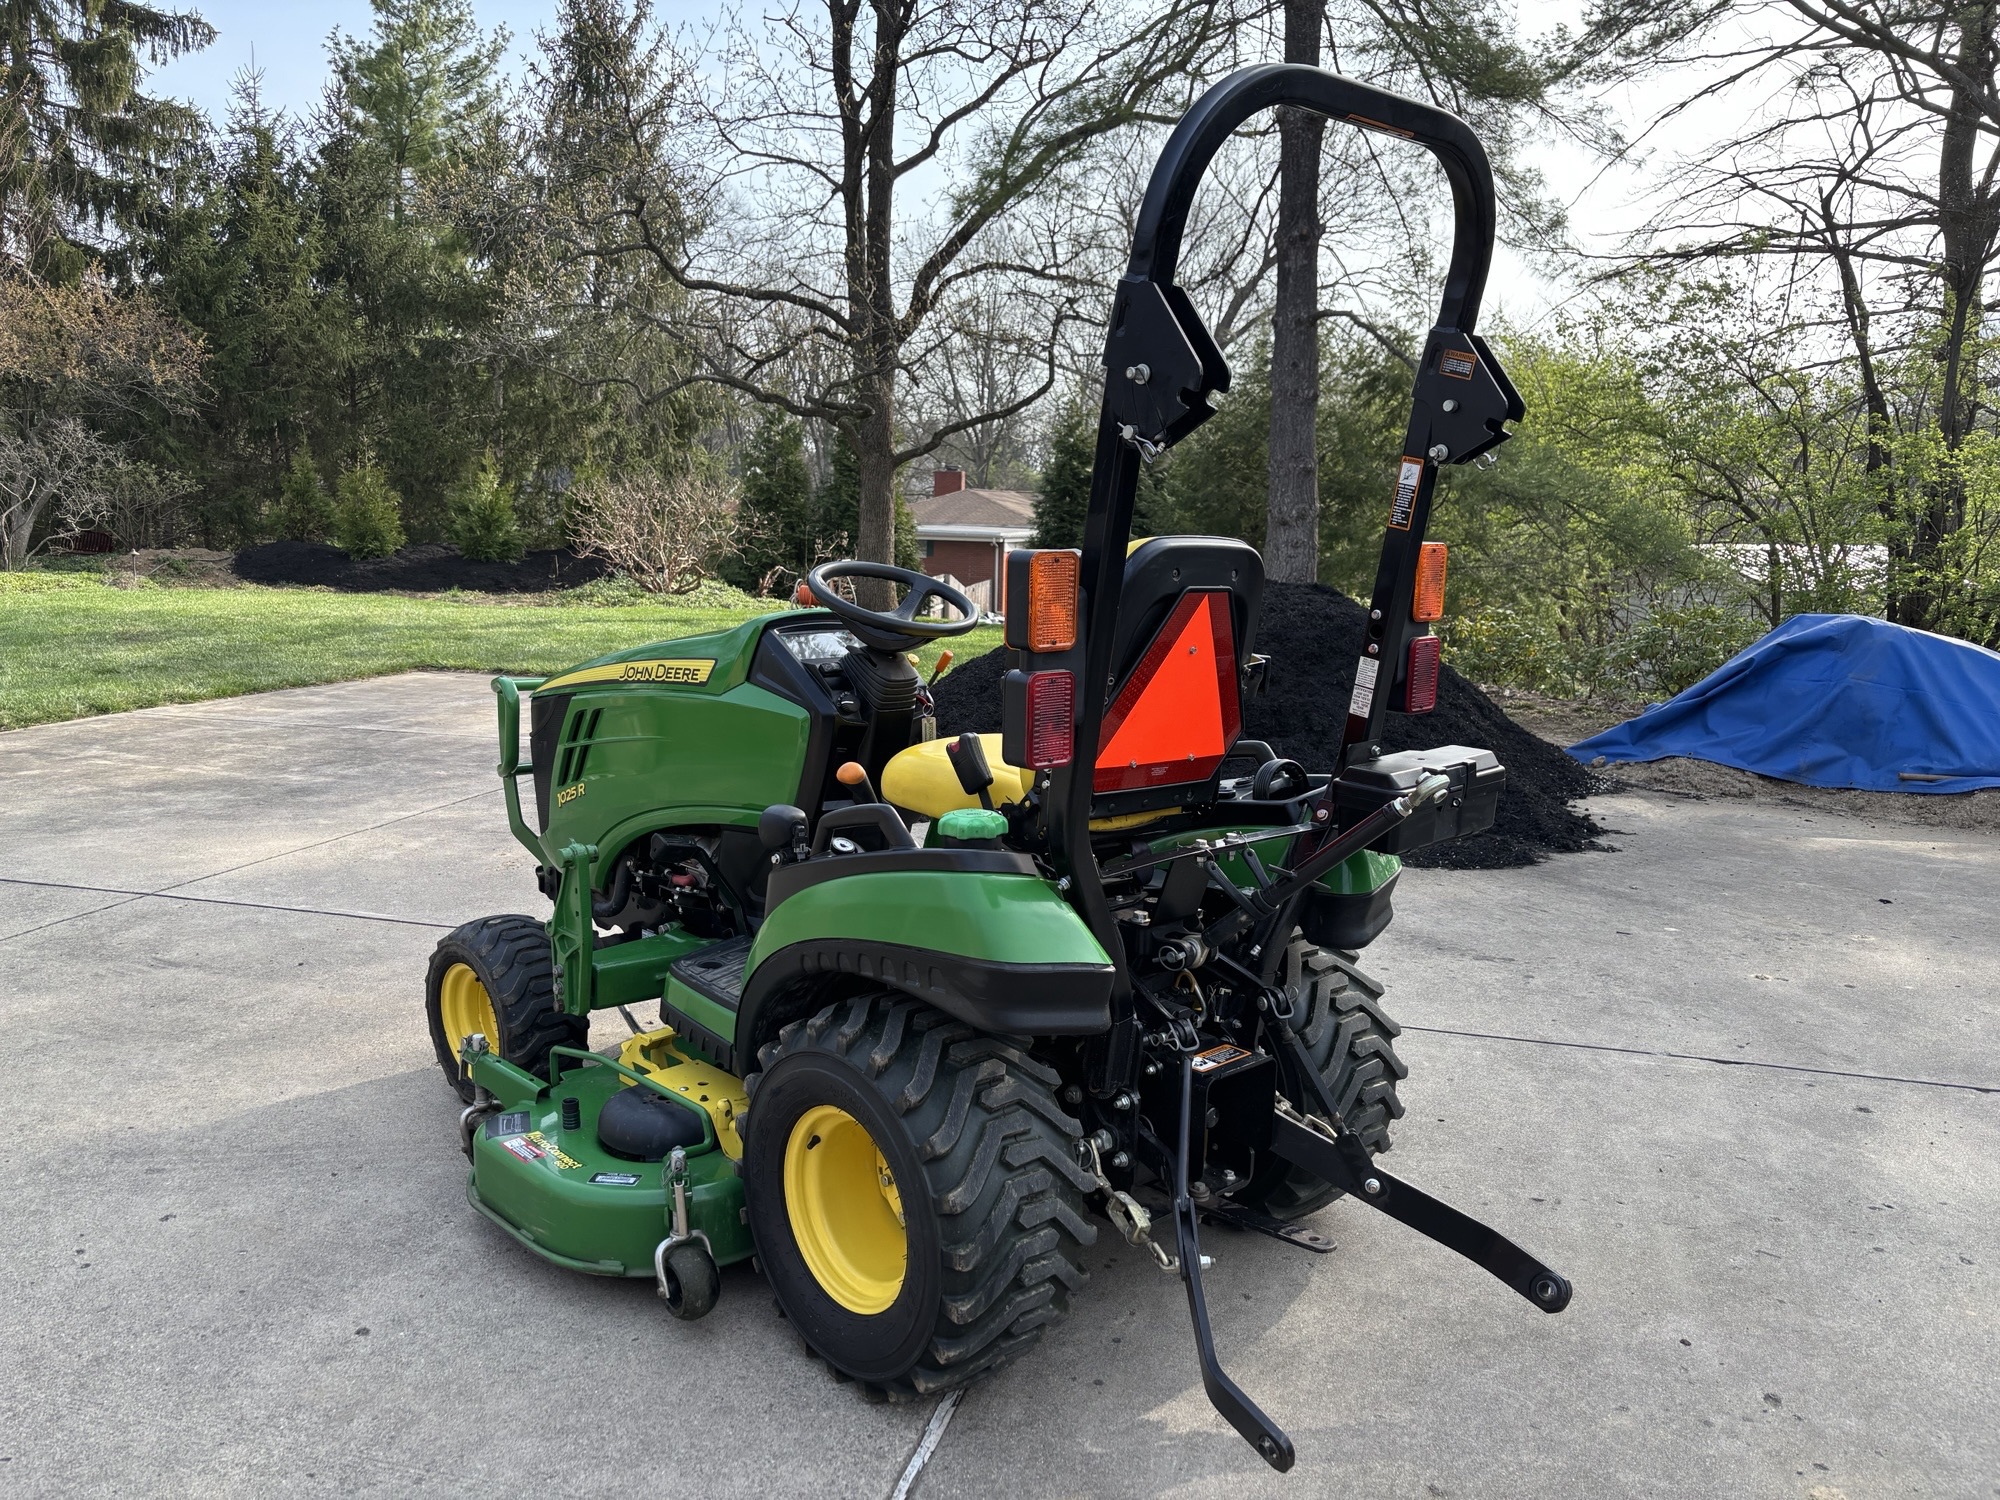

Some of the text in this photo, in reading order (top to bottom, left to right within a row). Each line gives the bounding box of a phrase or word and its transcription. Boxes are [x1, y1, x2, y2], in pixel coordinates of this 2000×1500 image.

[1450, 351, 1475, 361] WARNING
[619, 664, 701, 681] JOHN DEERE
[557, 783, 586, 808] 1025 R
